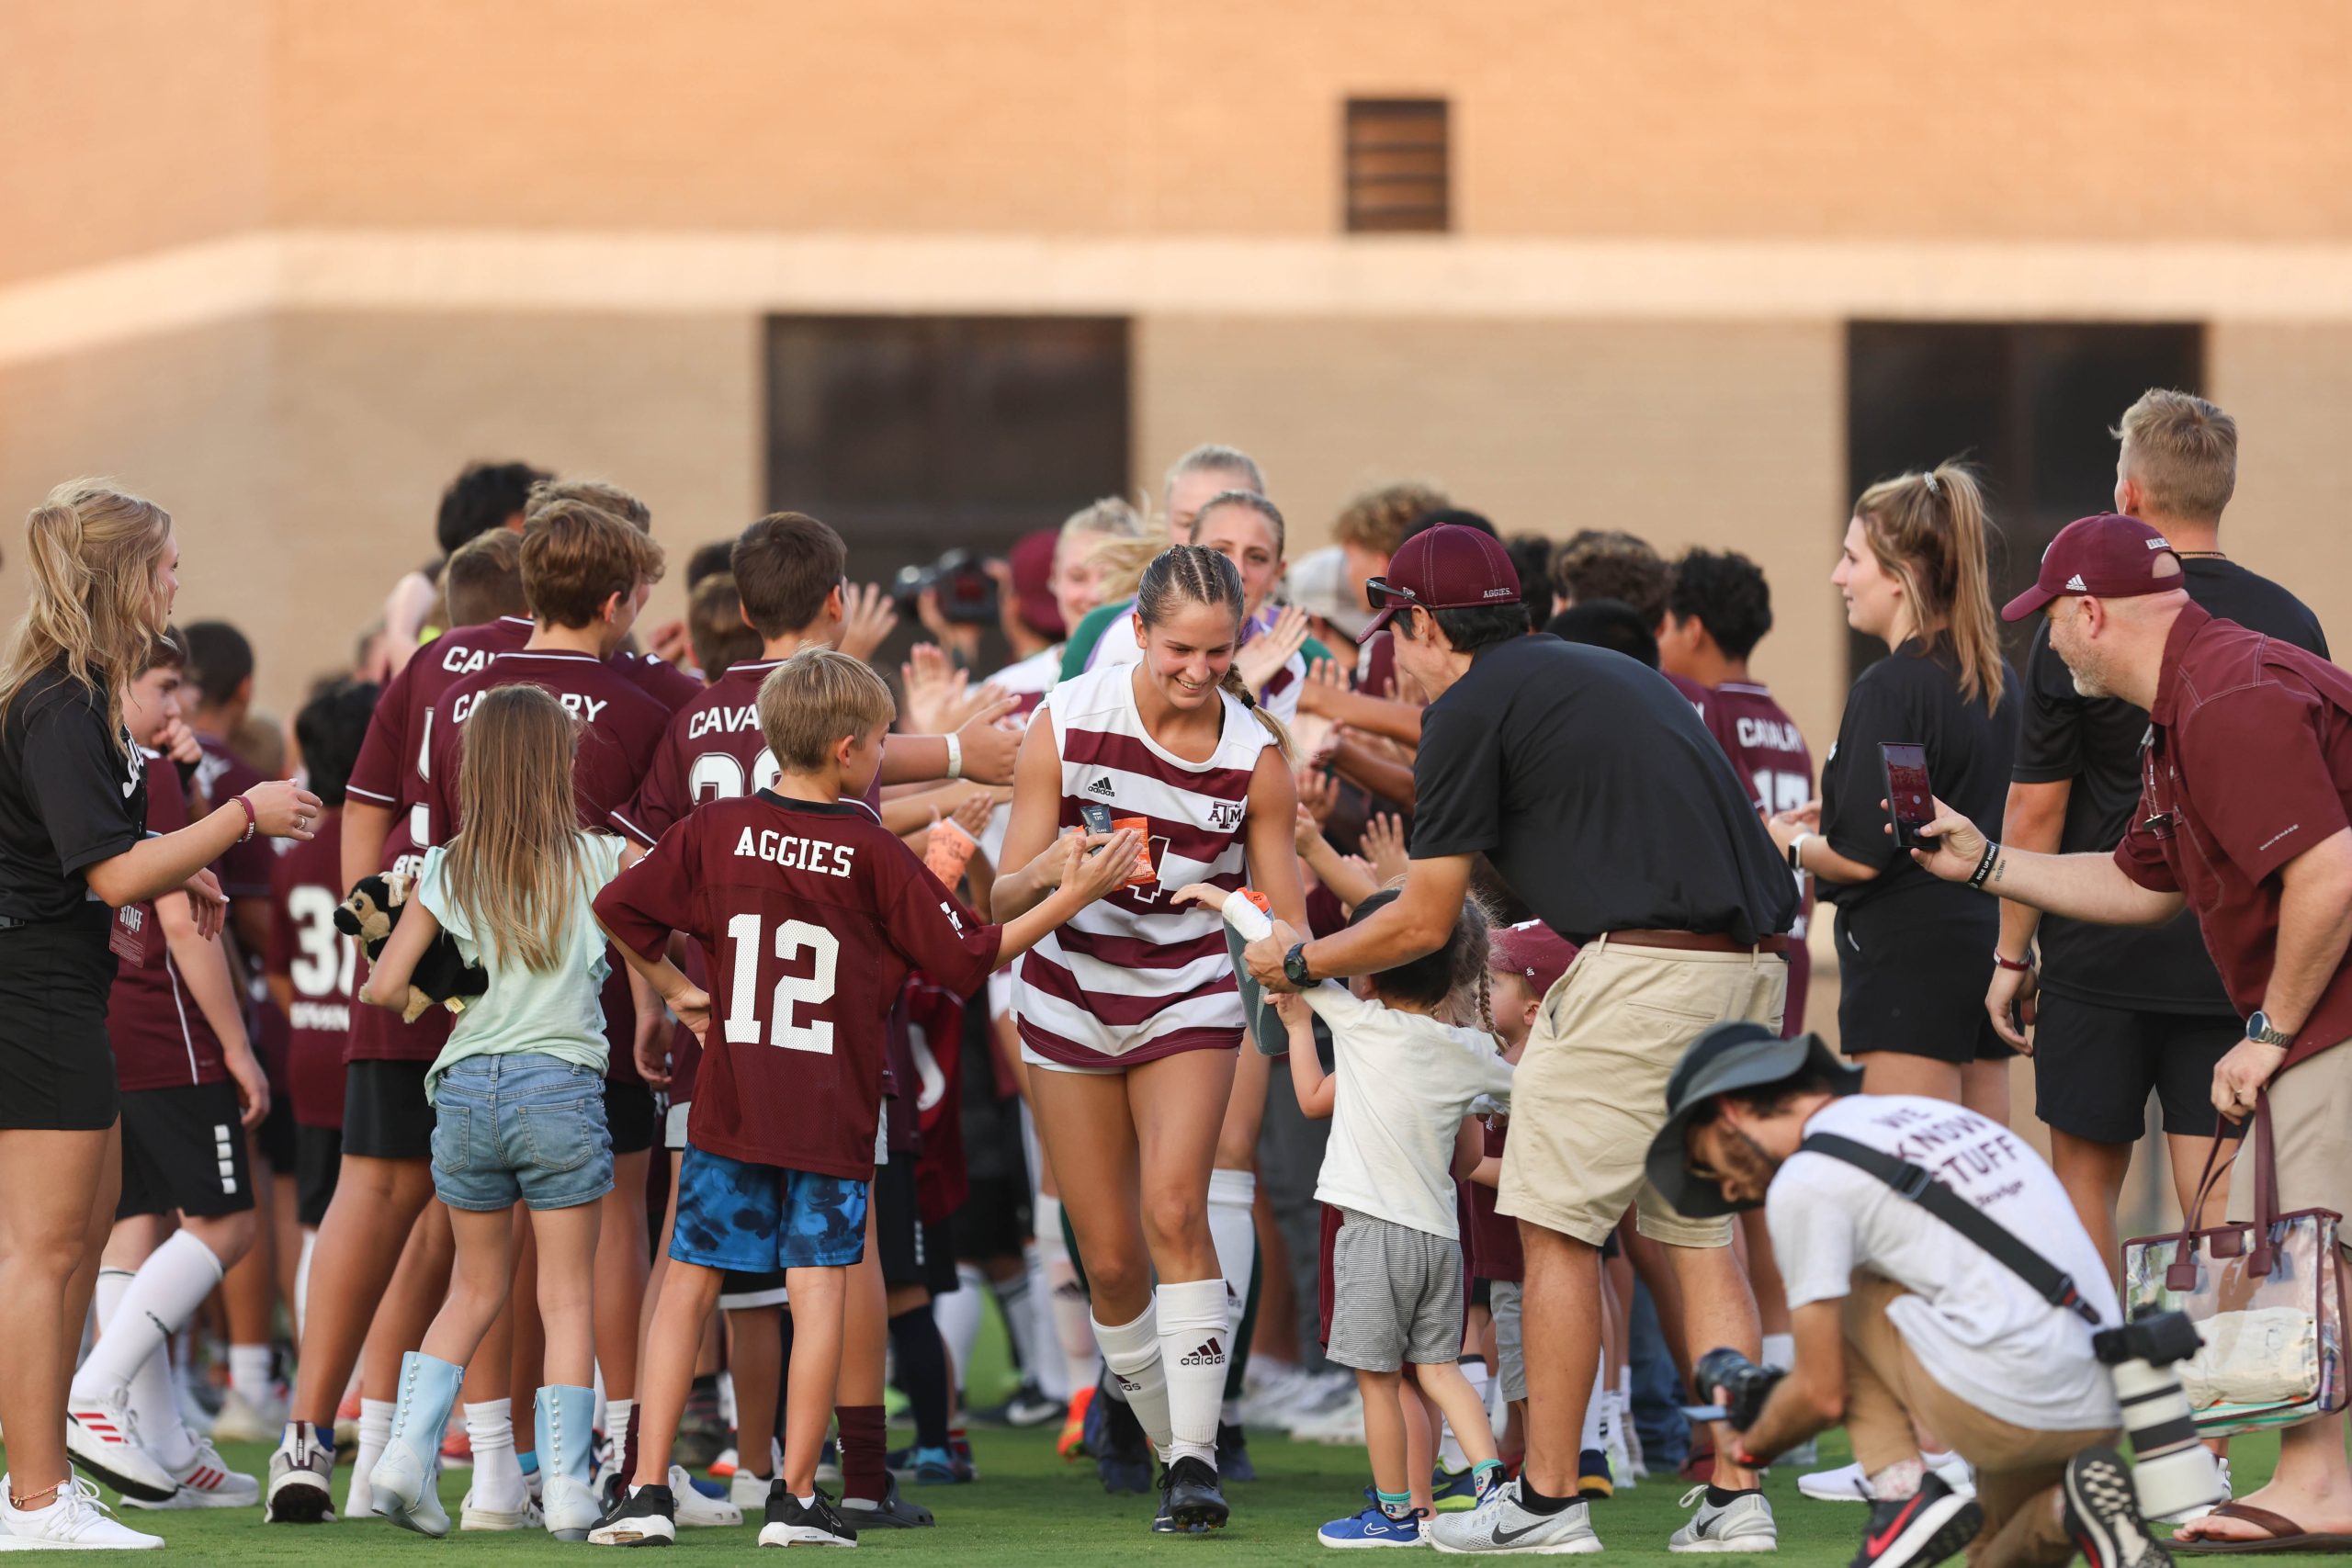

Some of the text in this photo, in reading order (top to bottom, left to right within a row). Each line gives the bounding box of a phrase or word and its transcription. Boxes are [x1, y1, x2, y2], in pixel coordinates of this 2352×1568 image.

[1483, 587, 1510, 598] AGGIES
[1088, 785, 1115, 798] adidas
[734, 826, 855, 878] AGGIES
[119, 905, 143, 931] STAFF
[724, 913, 840, 1055] 12
[1896, 1115, 1987, 1160] KNOW
[1181, 1354, 1226, 1366] adidas
